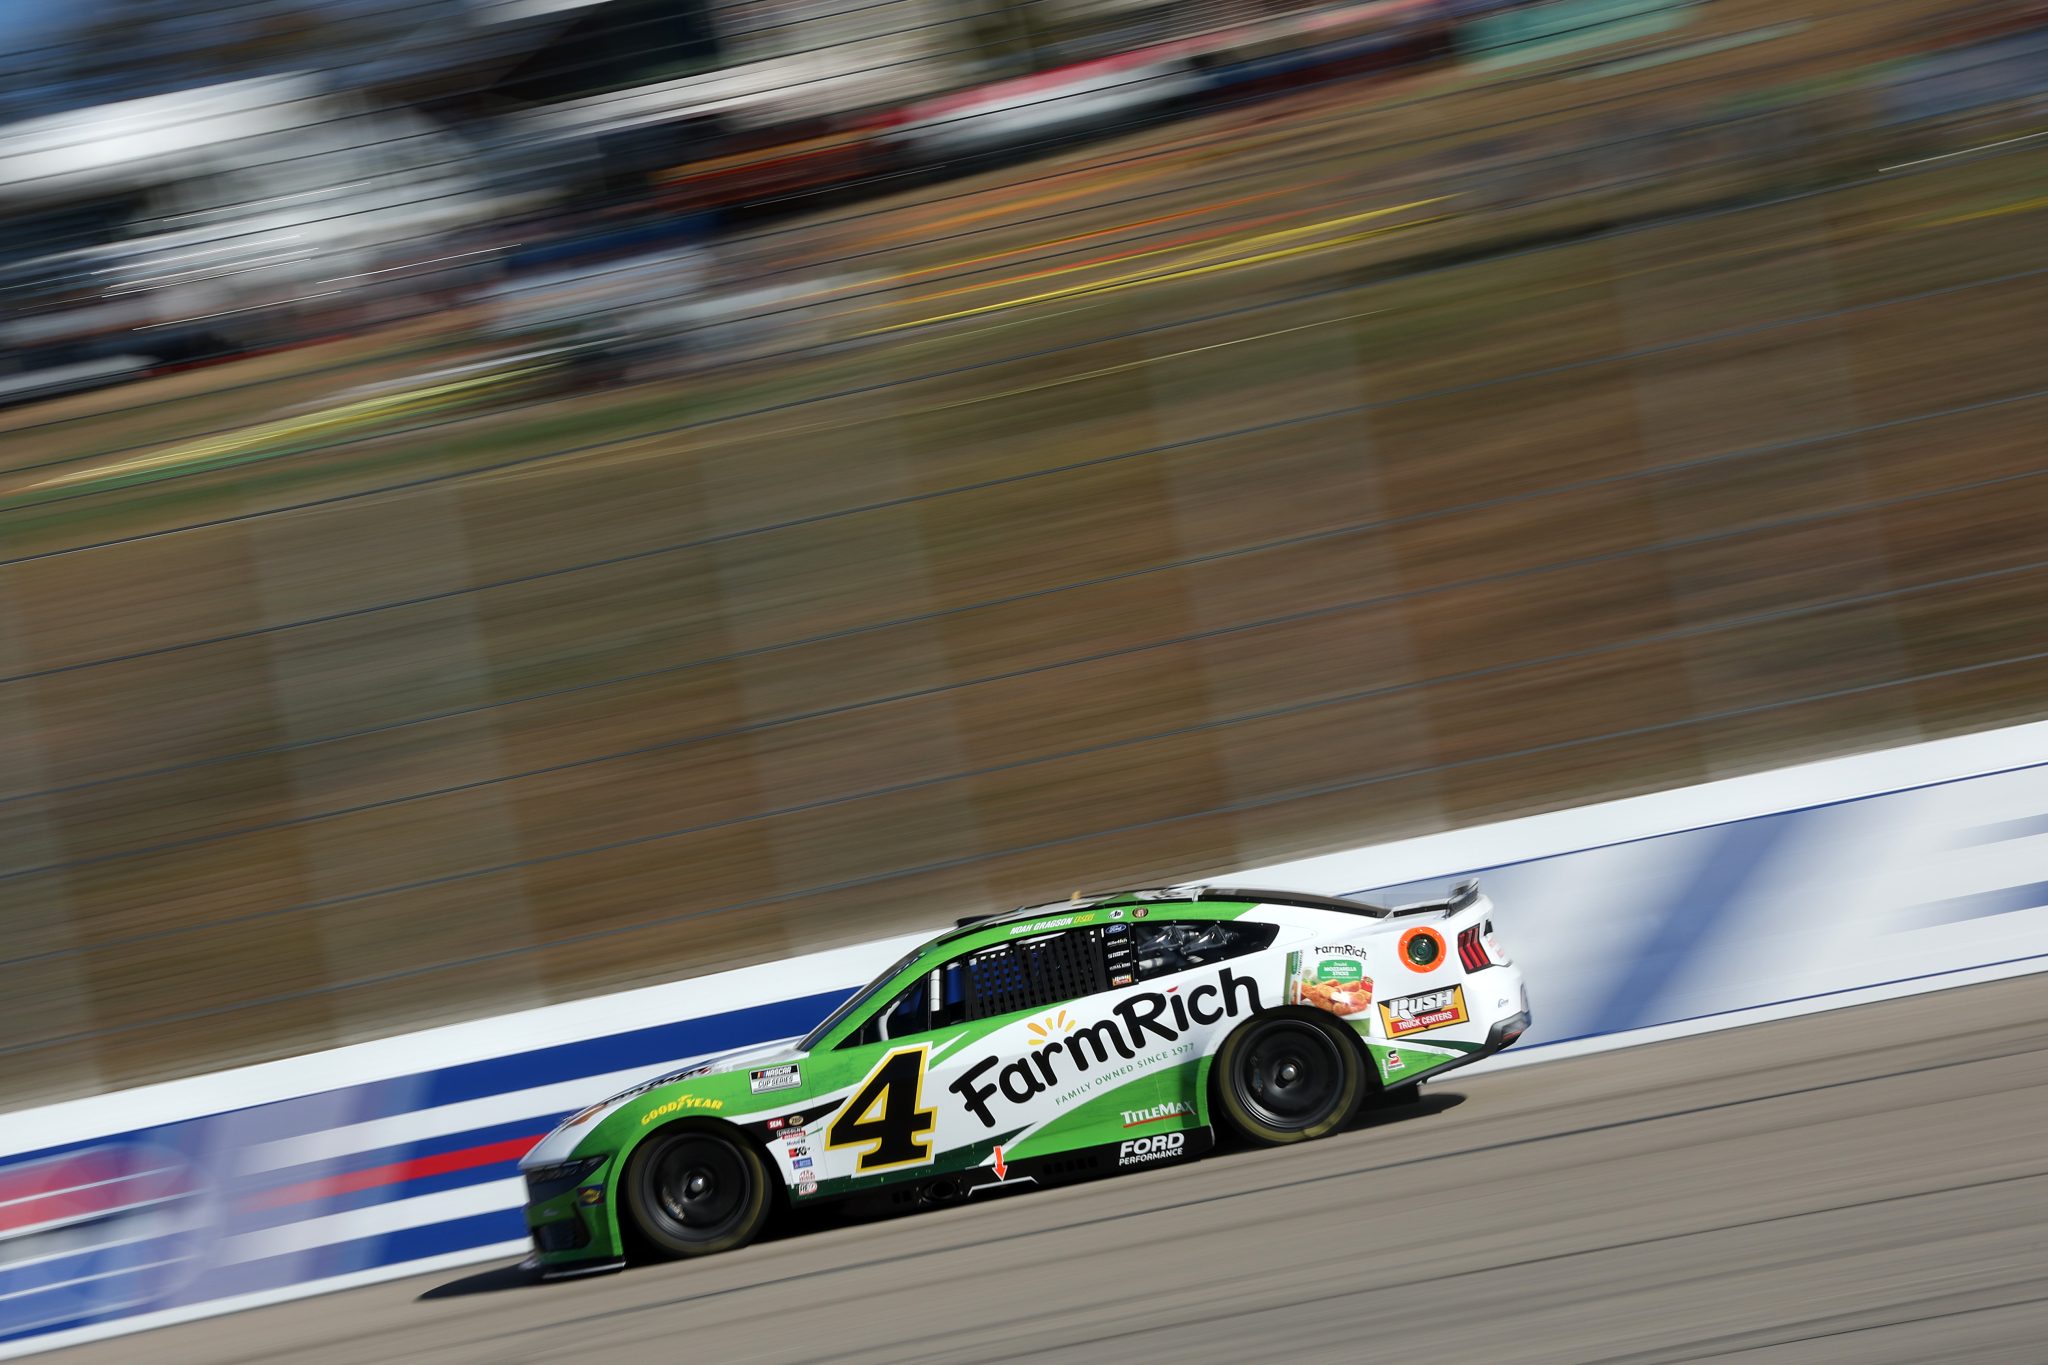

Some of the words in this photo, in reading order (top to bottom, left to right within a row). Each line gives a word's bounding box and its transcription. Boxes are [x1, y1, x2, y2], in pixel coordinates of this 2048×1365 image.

[1010, 924, 1033, 936] NOAH
[1034, 917, 1073, 931] GRAGSON
[1398, 1018, 1421, 1030] TRUCK
[1422, 1011, 1452, 1025] CENTERS
[949, 967, 1265, 1128] FarmRich
[758, 1079, 771, 1088] CUP
[772, 1075, 794, 1087] SERIES
[765, 1066, 792, 1078] NASCAR
[1055, 1082, 1091, 1105] FAMILY
[1095, 1065, 1133, 1085] OWNED
[1137, 1051, 1168, 1069] SINCE
[1172, 1042, 1195, 1056] 1977
[641, 1094, 723, 1125] GOODYEAR
[824, 1046, 938, 1173] 4
[1120, 1132, 1184, 1158] FORD
[1119, 1147, 1183, 1166] PERFORMANCE
